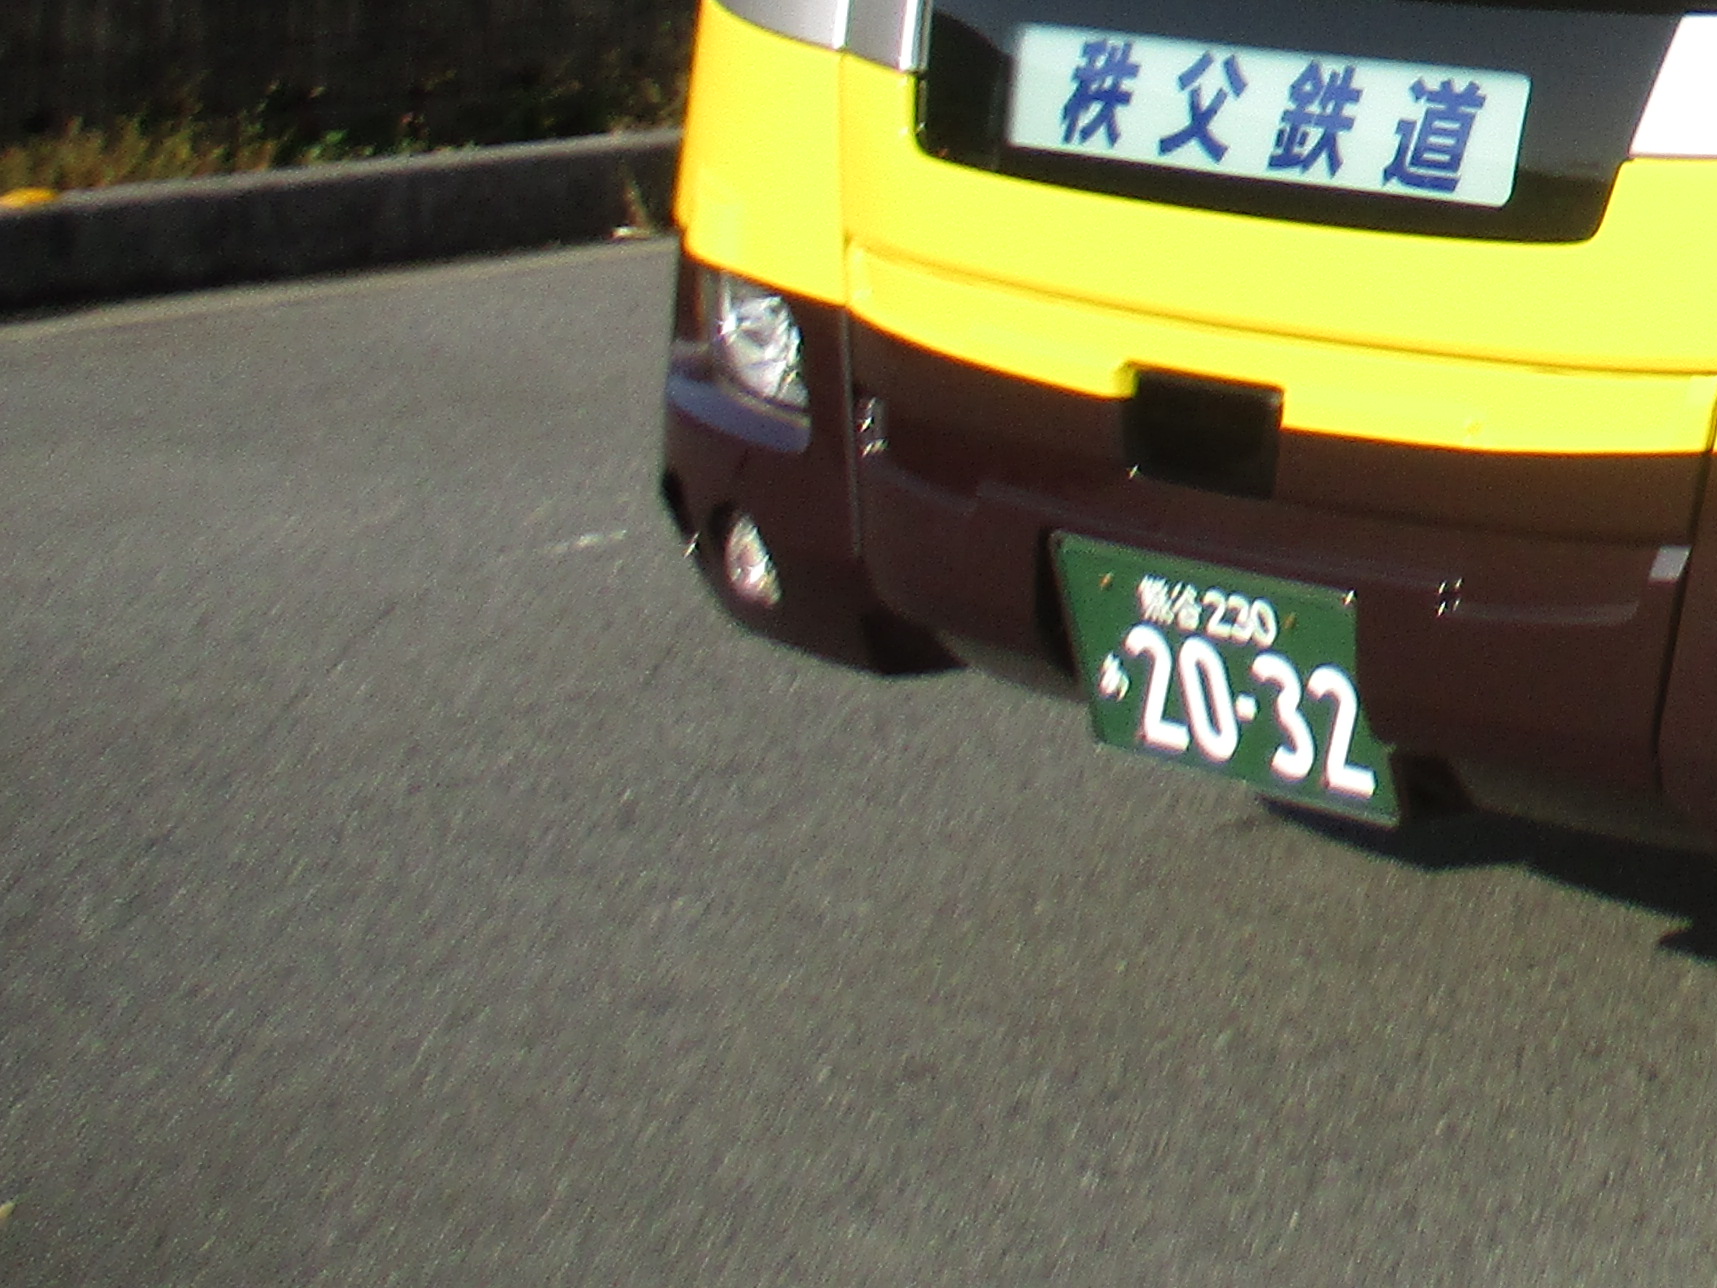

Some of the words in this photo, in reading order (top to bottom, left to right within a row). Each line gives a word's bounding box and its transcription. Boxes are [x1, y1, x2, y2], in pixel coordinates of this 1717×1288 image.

[1059, 38, 1487, 193] 秩父鉄道
[1202, 586, 1278, 649] 230
